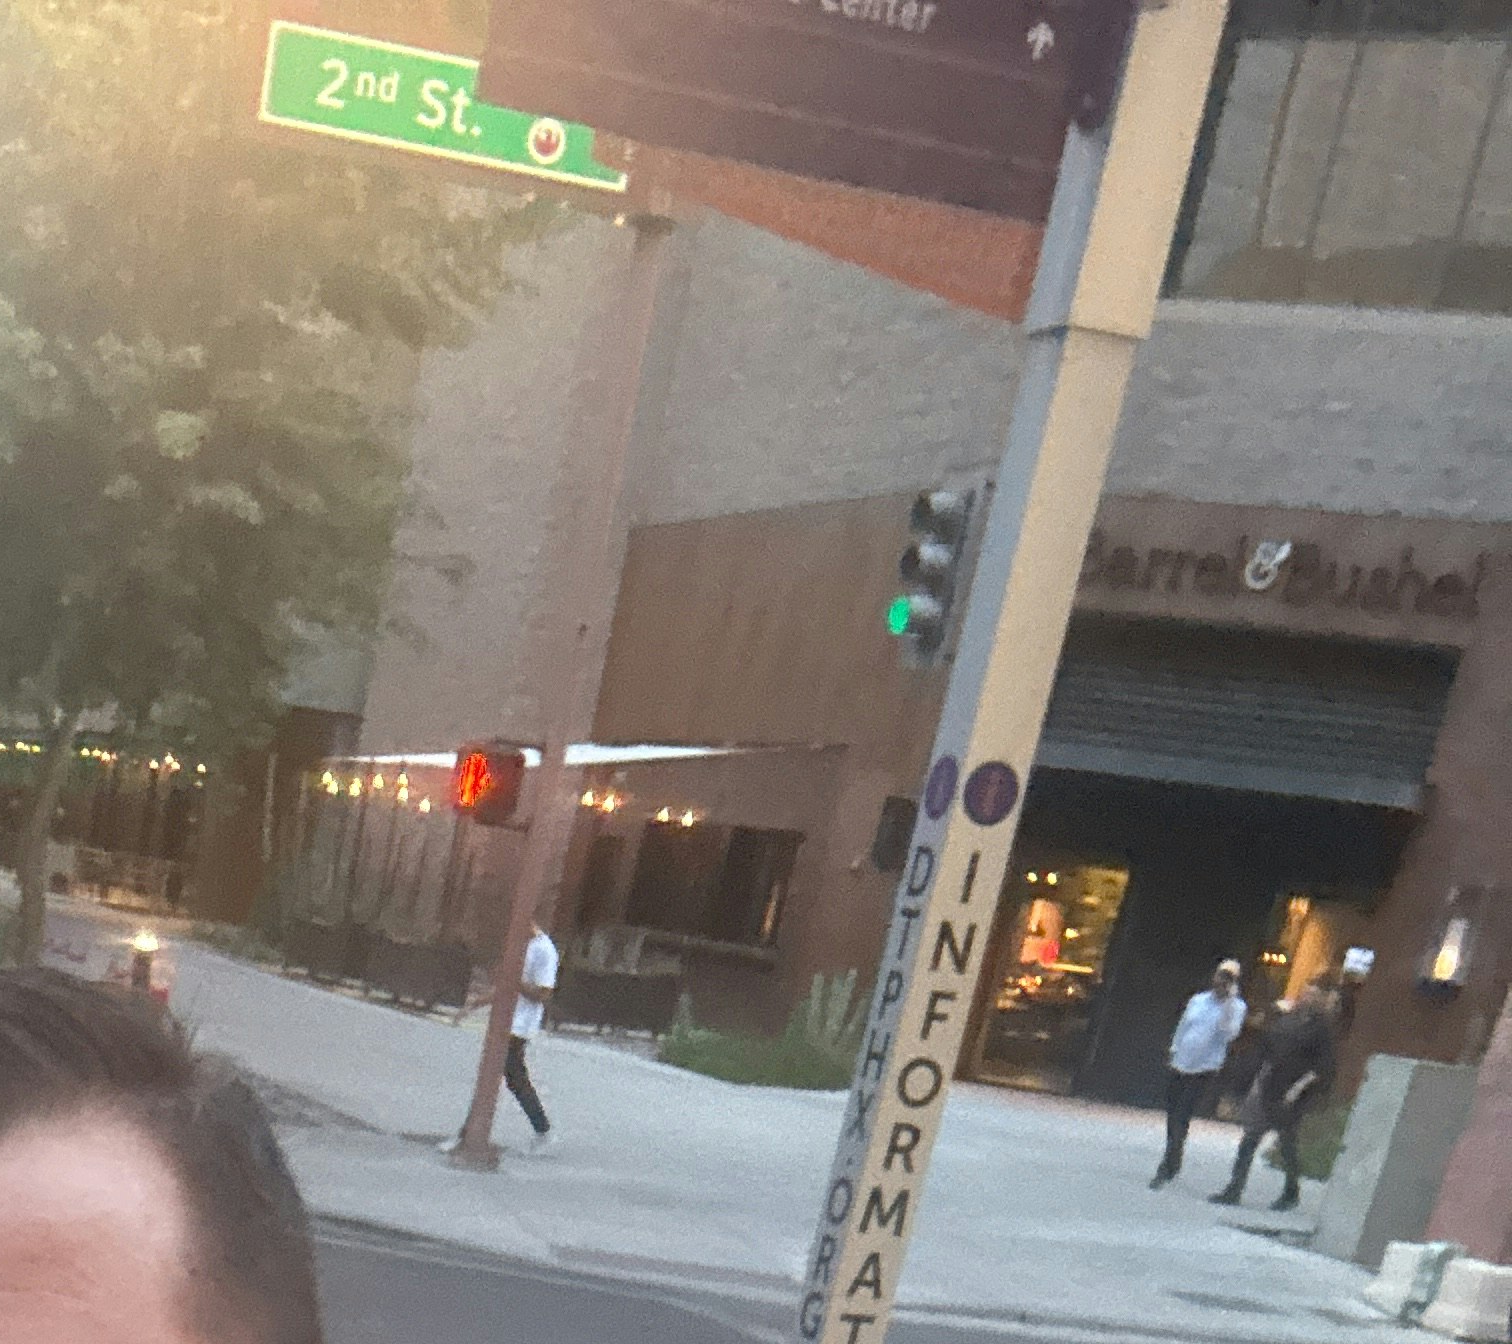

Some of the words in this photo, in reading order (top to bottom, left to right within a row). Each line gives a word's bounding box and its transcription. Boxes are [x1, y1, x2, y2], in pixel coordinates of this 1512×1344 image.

[821, 0, 937, 33] enter
[315, 57, 400, 109] 2nd
[416, 79, 482, 137] St.
